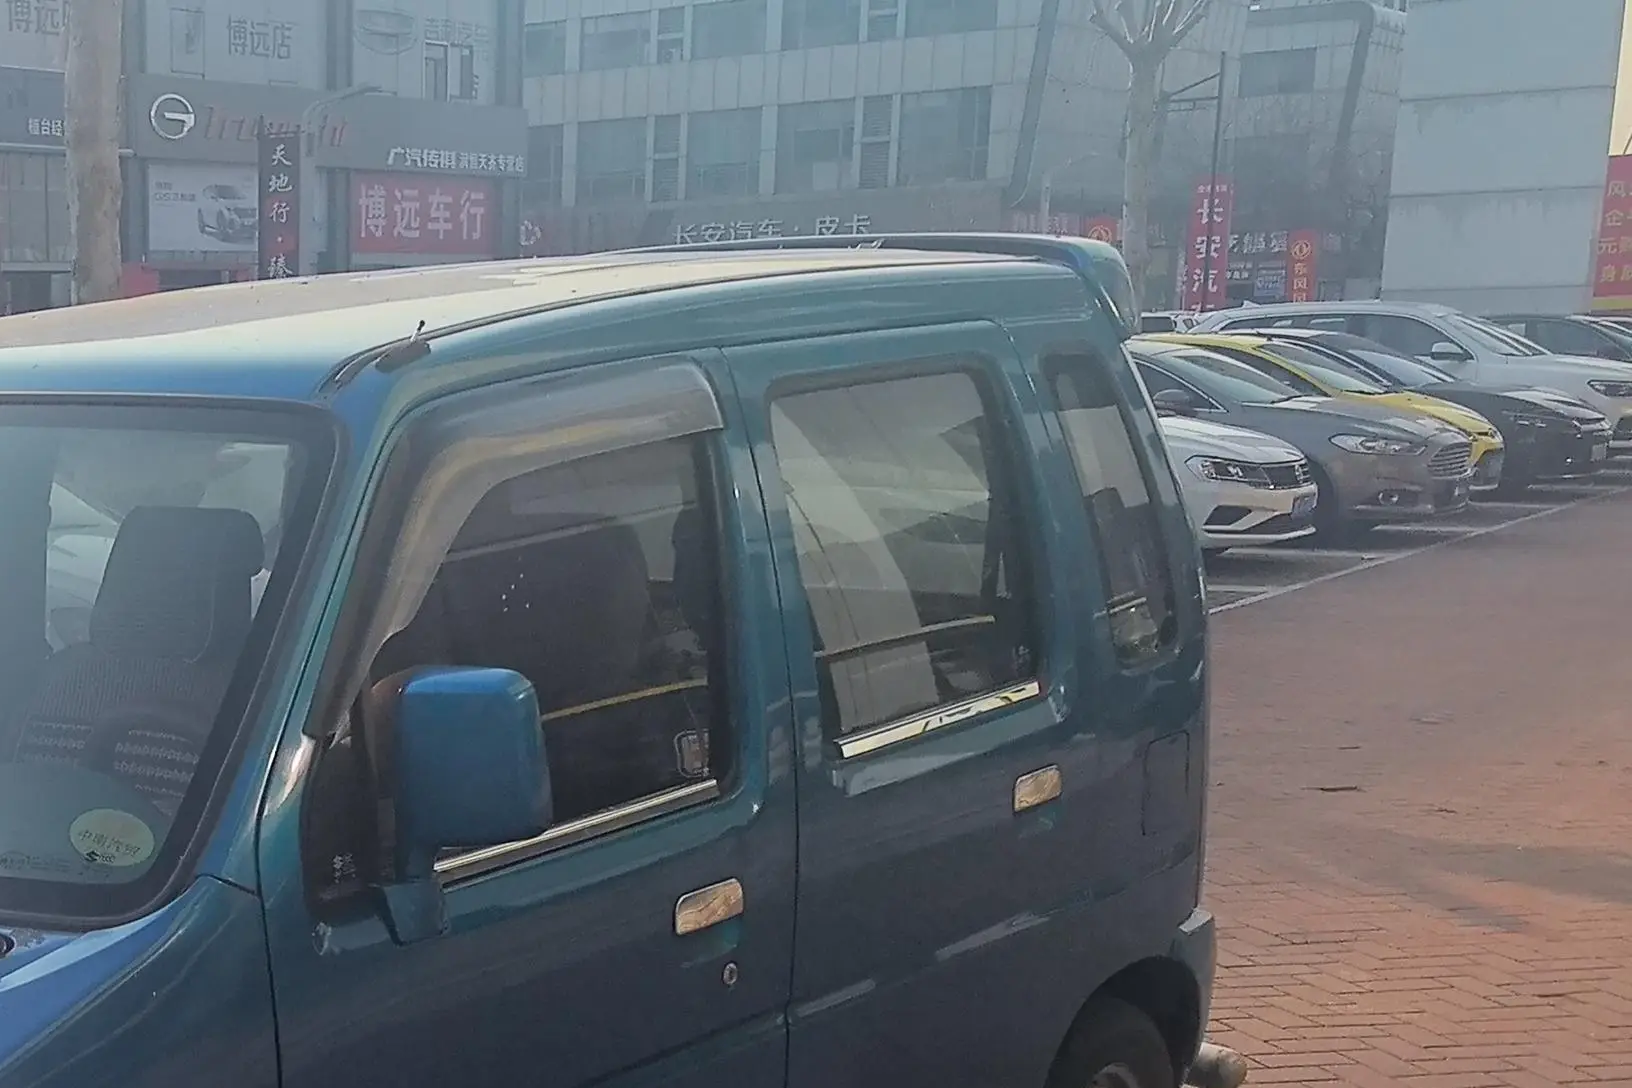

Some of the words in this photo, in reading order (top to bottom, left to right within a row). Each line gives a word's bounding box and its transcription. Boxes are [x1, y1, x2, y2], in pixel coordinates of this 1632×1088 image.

[226, 14, 296, 60] 博远店
[358, 183, 487, 241] 博远车行
